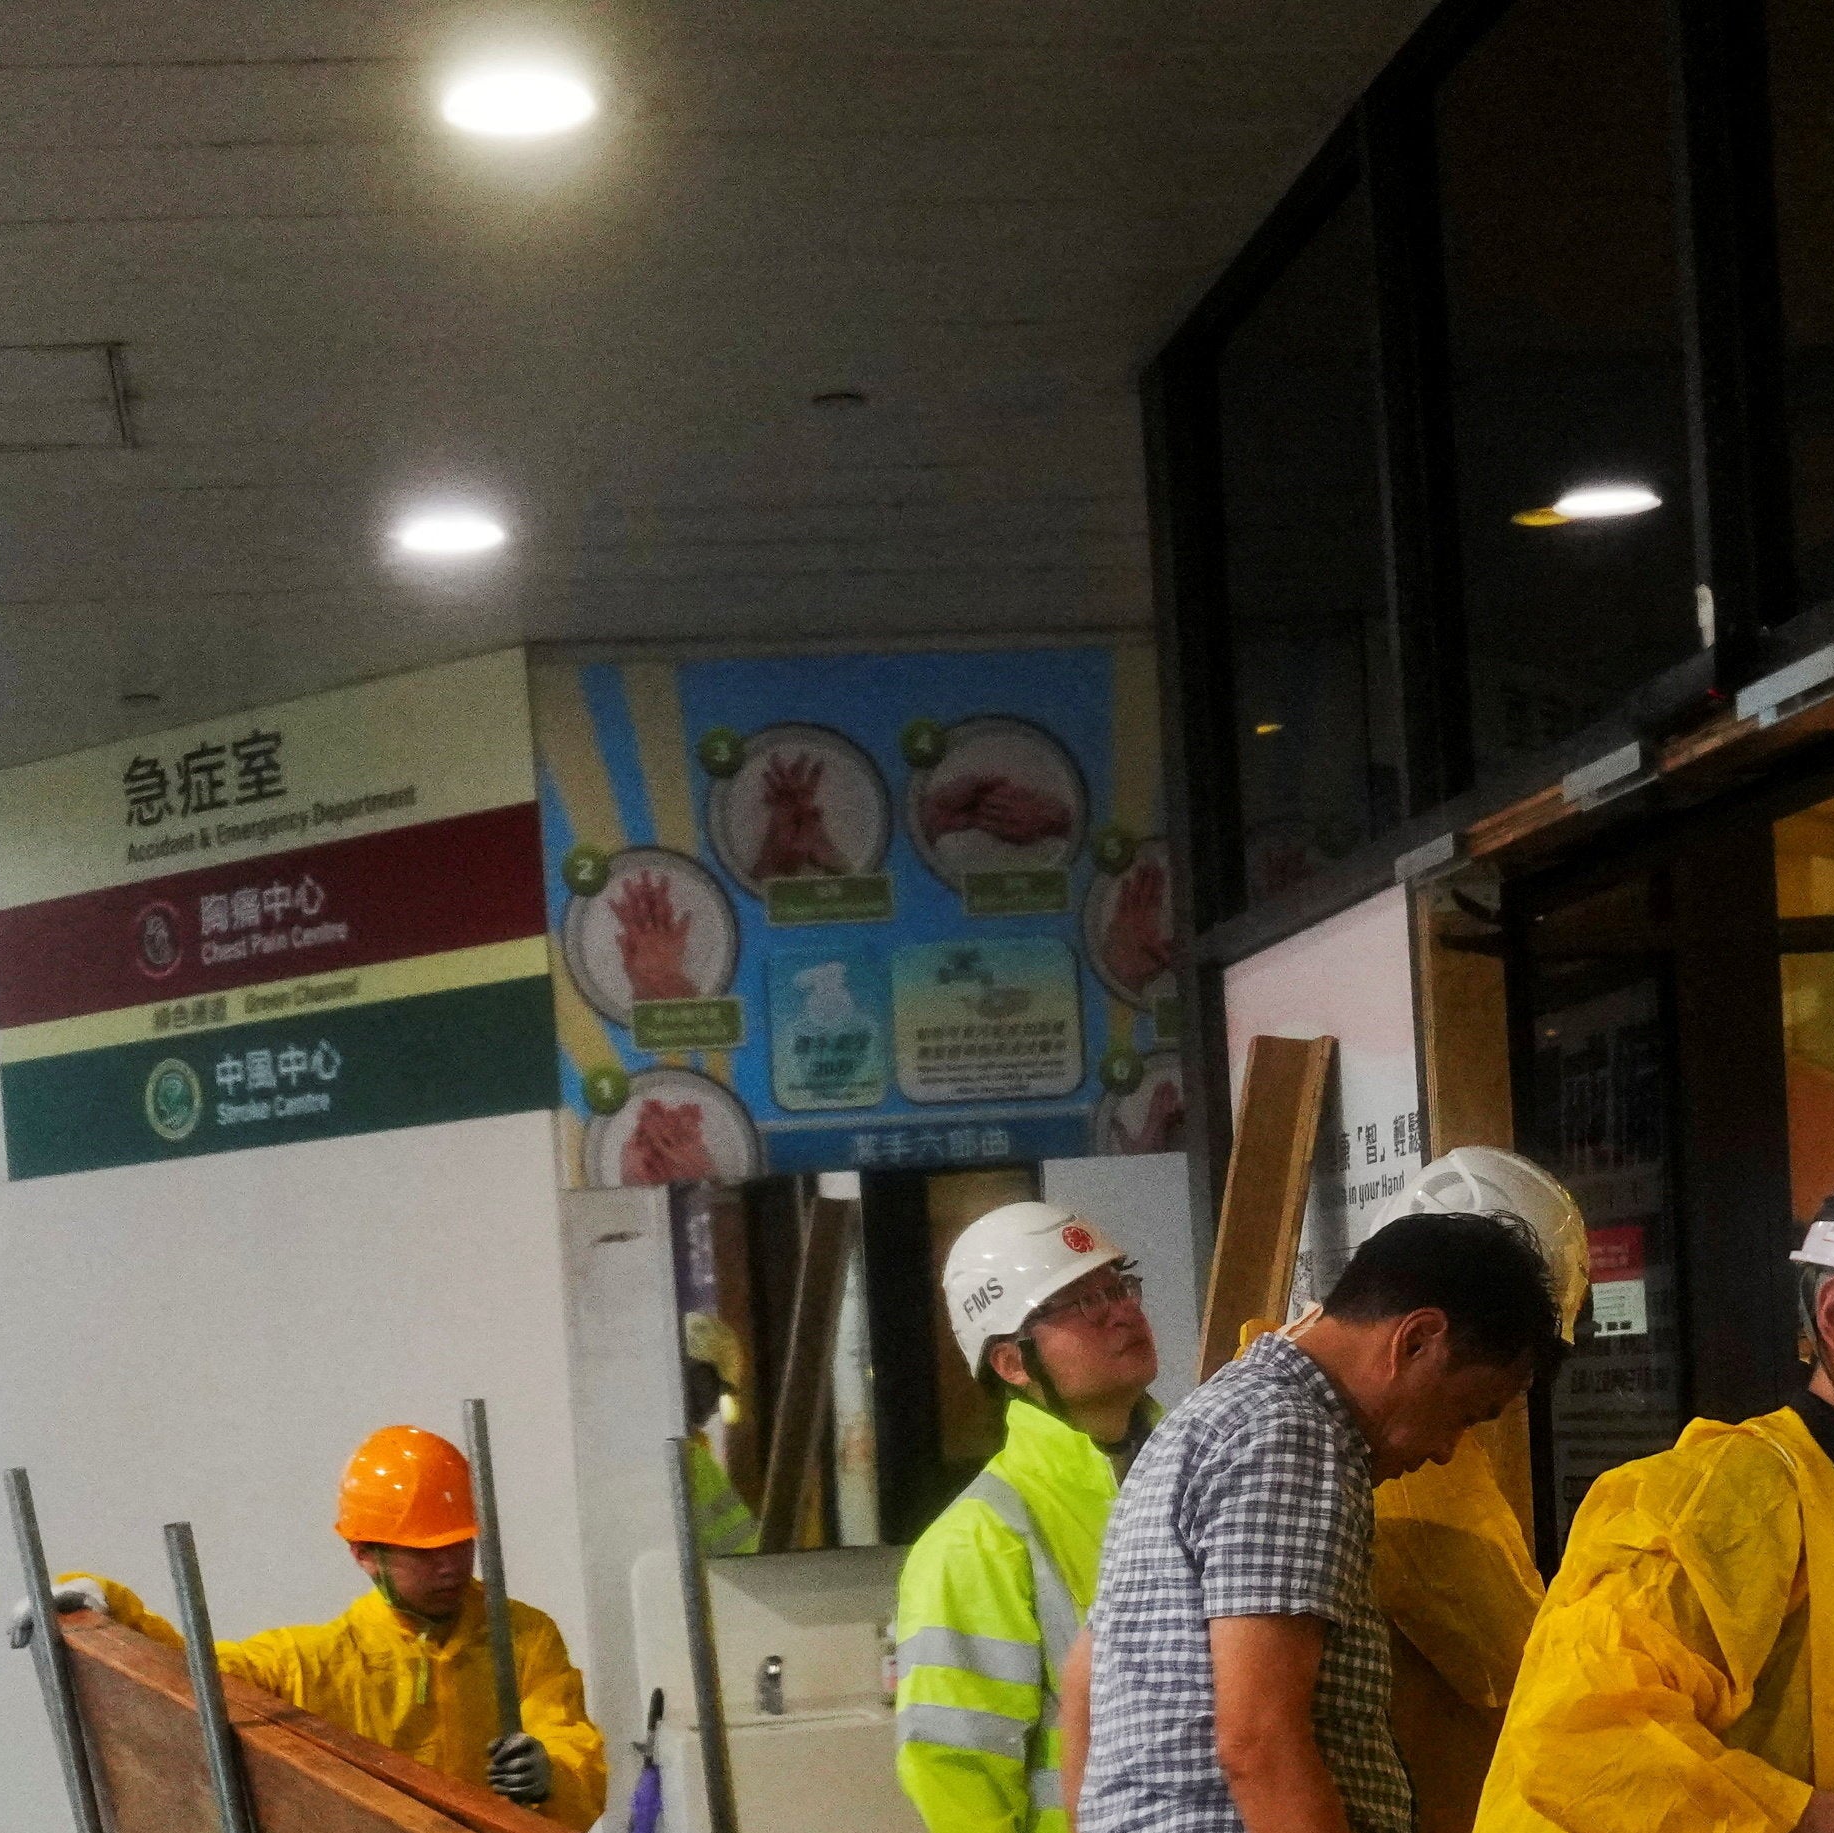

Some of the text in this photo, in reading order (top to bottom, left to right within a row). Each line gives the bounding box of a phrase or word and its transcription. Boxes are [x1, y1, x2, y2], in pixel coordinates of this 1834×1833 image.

[123, 728, 287, 828] 急症室
[577, 859, 594, 880] 2
[597, 1078, 611, 1099] 1
[1358, 1181, 1380, 1210] your
[1381, 1169, 1405, 1198] Hand
[963, 1277, 1004, 1322] FMS
